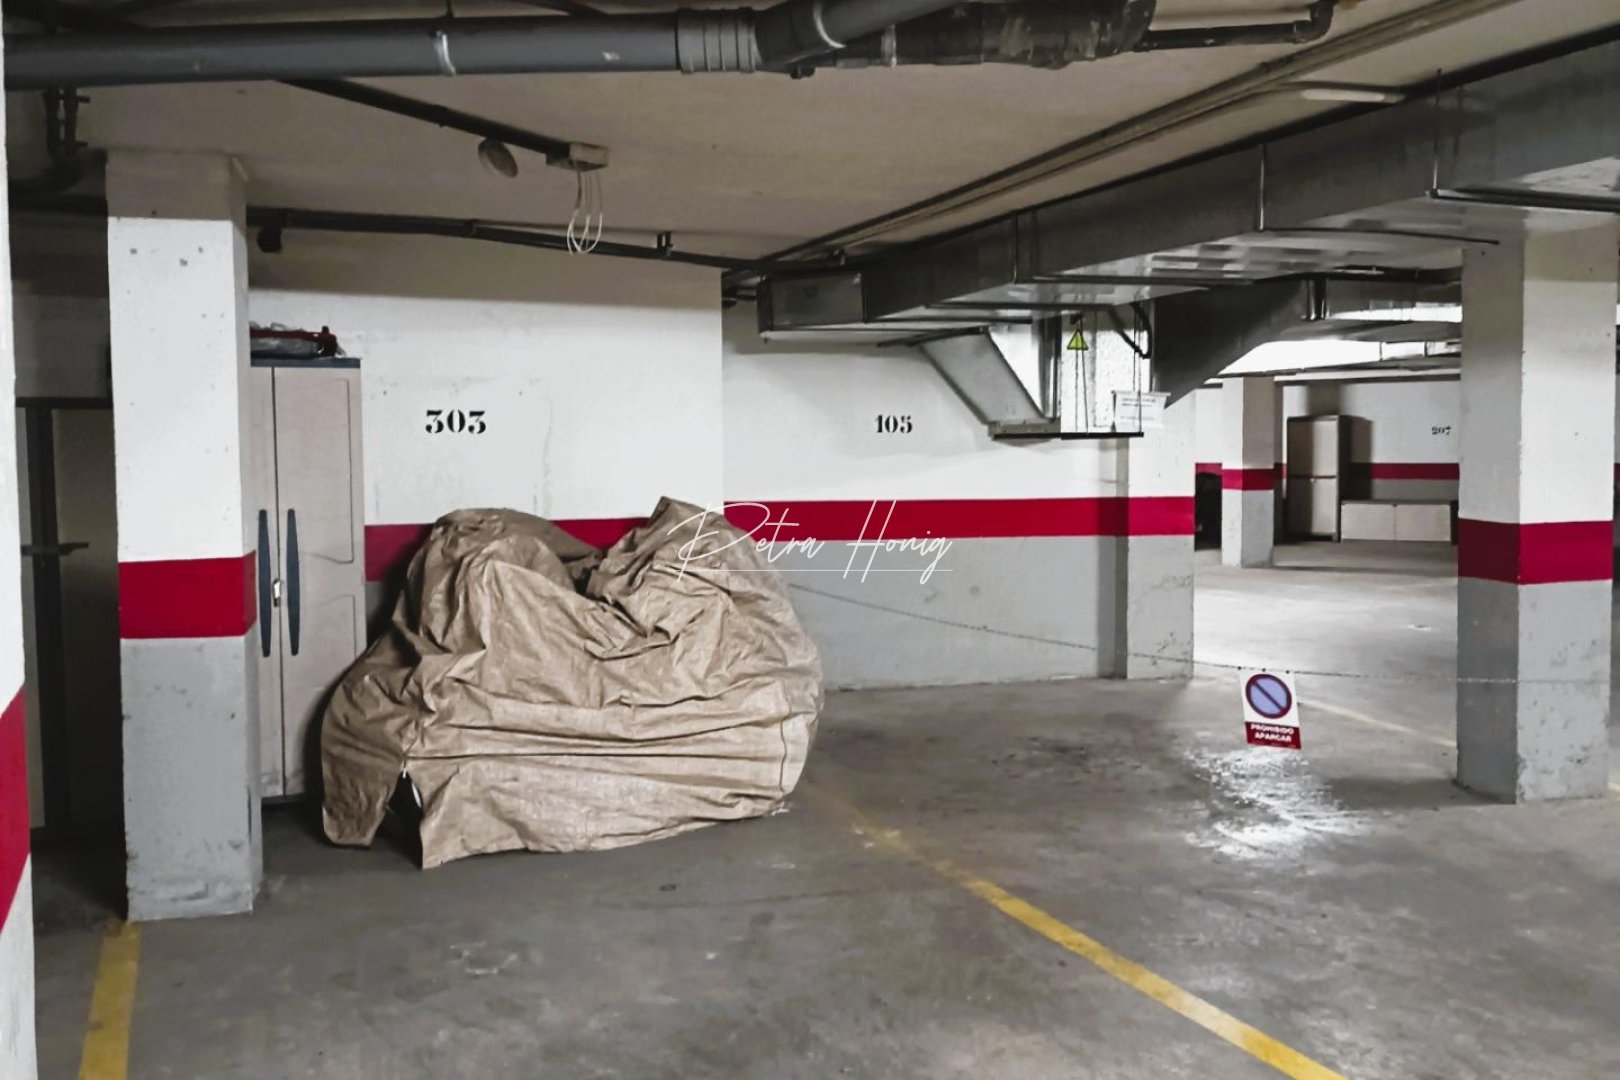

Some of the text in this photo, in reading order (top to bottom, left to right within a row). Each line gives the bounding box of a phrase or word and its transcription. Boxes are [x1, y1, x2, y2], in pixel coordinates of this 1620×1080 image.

[425, 409, 486, 434] 303
[875, 414, 912, 433] 105
[1250, 723, 1294, 735] PROHIBIDO
[1254, 731, 1292, 742] APARCAR
